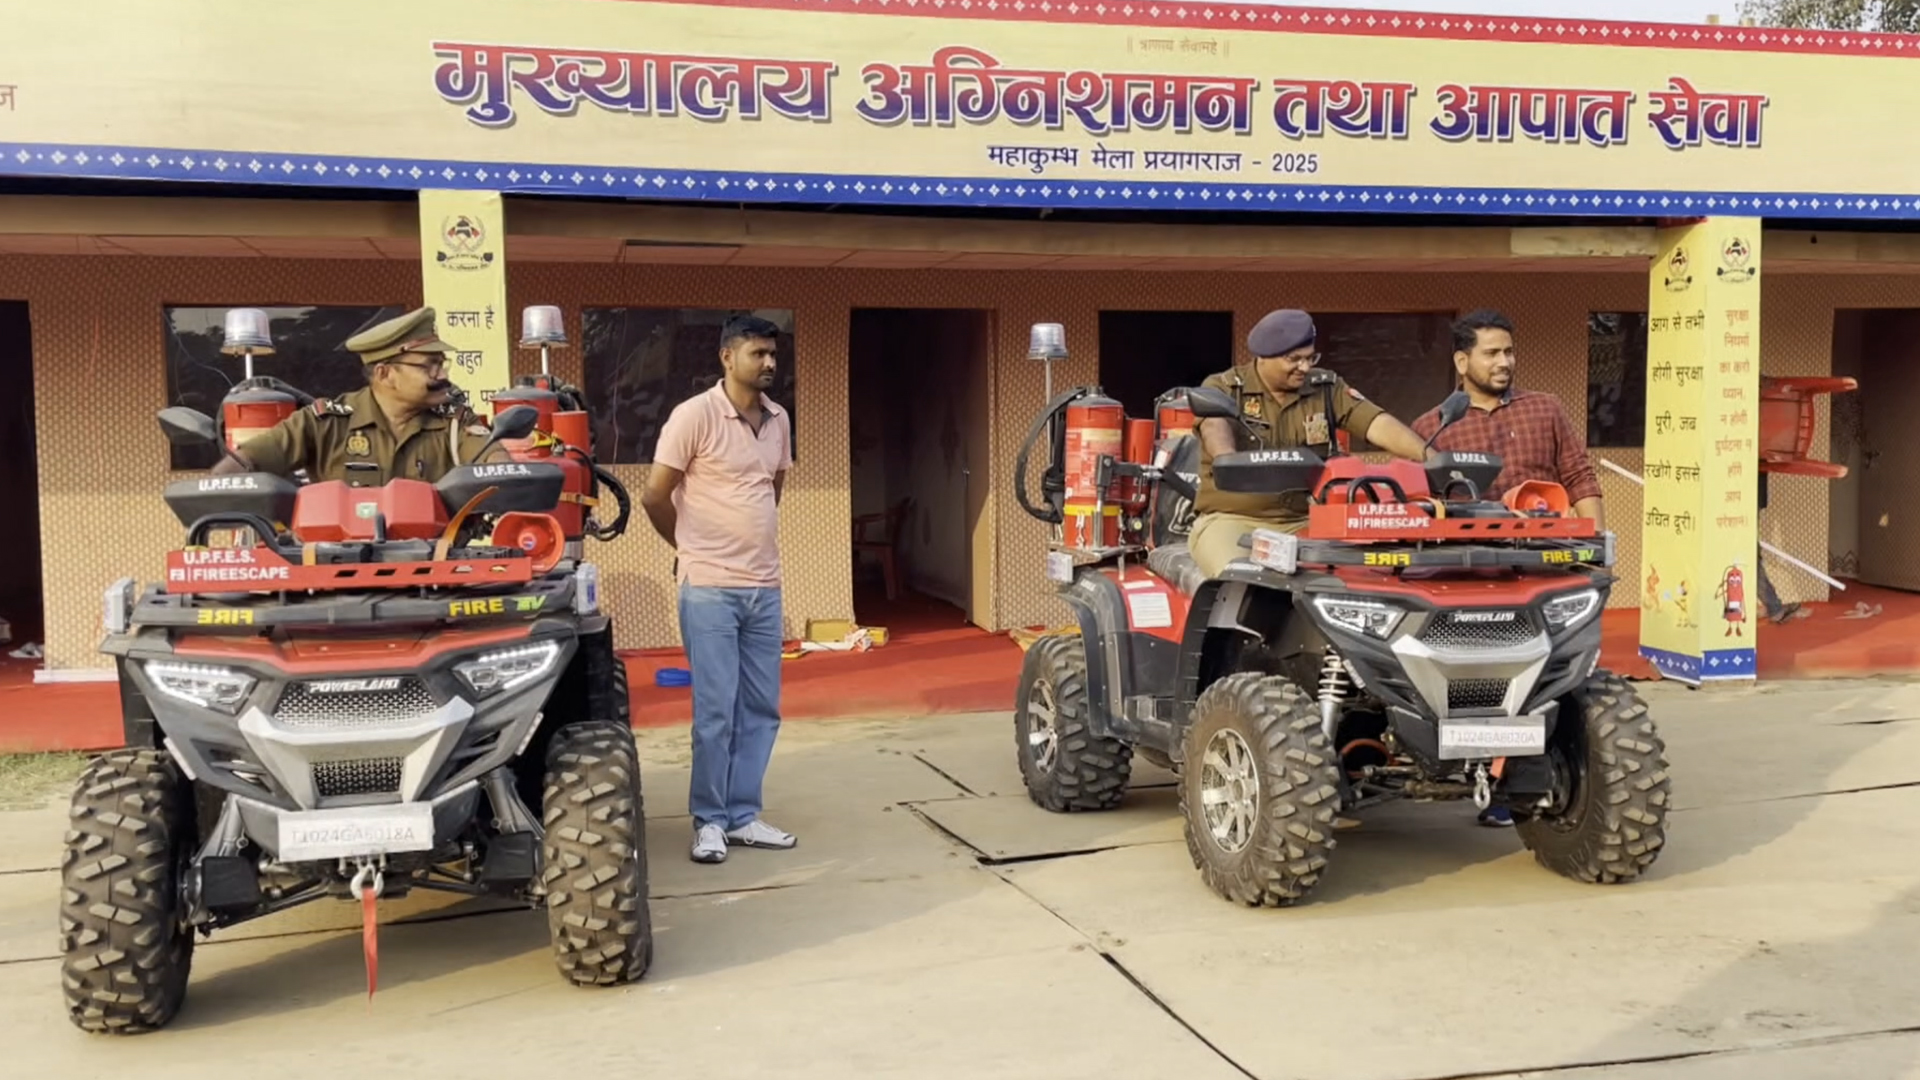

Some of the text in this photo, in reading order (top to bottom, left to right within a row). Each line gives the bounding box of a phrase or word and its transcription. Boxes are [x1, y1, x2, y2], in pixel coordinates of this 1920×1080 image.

[431, 41, 1770, 150] मुख्यालय अग्निशमन तथा आपात सेवा
[986, 145, 1079, 174] महाकुम्भ
[1091, 142, 1135, 170] मेला
[1144, 151, 1242, 172] प्रयागराज
[1272, 153, 1318, 173] 2025
[446, 304, 495, 330] करना है
[1650, 309, 1705, 332] आग से तभी
[455, 350, 483, 374] बहुत
[1652, 361, 1704, 387] होगी सुरक्षा
[1250, 451, 1304, 463] U.P.F.E.S.
[473, 463, 532, 478] U.P.F.E.S.
[1675, 461, 1701, 484] इससे
[198, 475, 258, 491] U.P.F.E.S.
[1358, 504, 1408, 516] U.P.F.E.S.
[1645, 506, 1670, 527] उचित
[1364, 517, 1430, 529] FIREESCAPE
[183, 549, 256, 566] U.P.F.E.S.
[1542, 551, 1573, 563] FIRE
[193, 566, 290, 581] FIREESCAPE
[449, 598, 505, 617] FIRE
